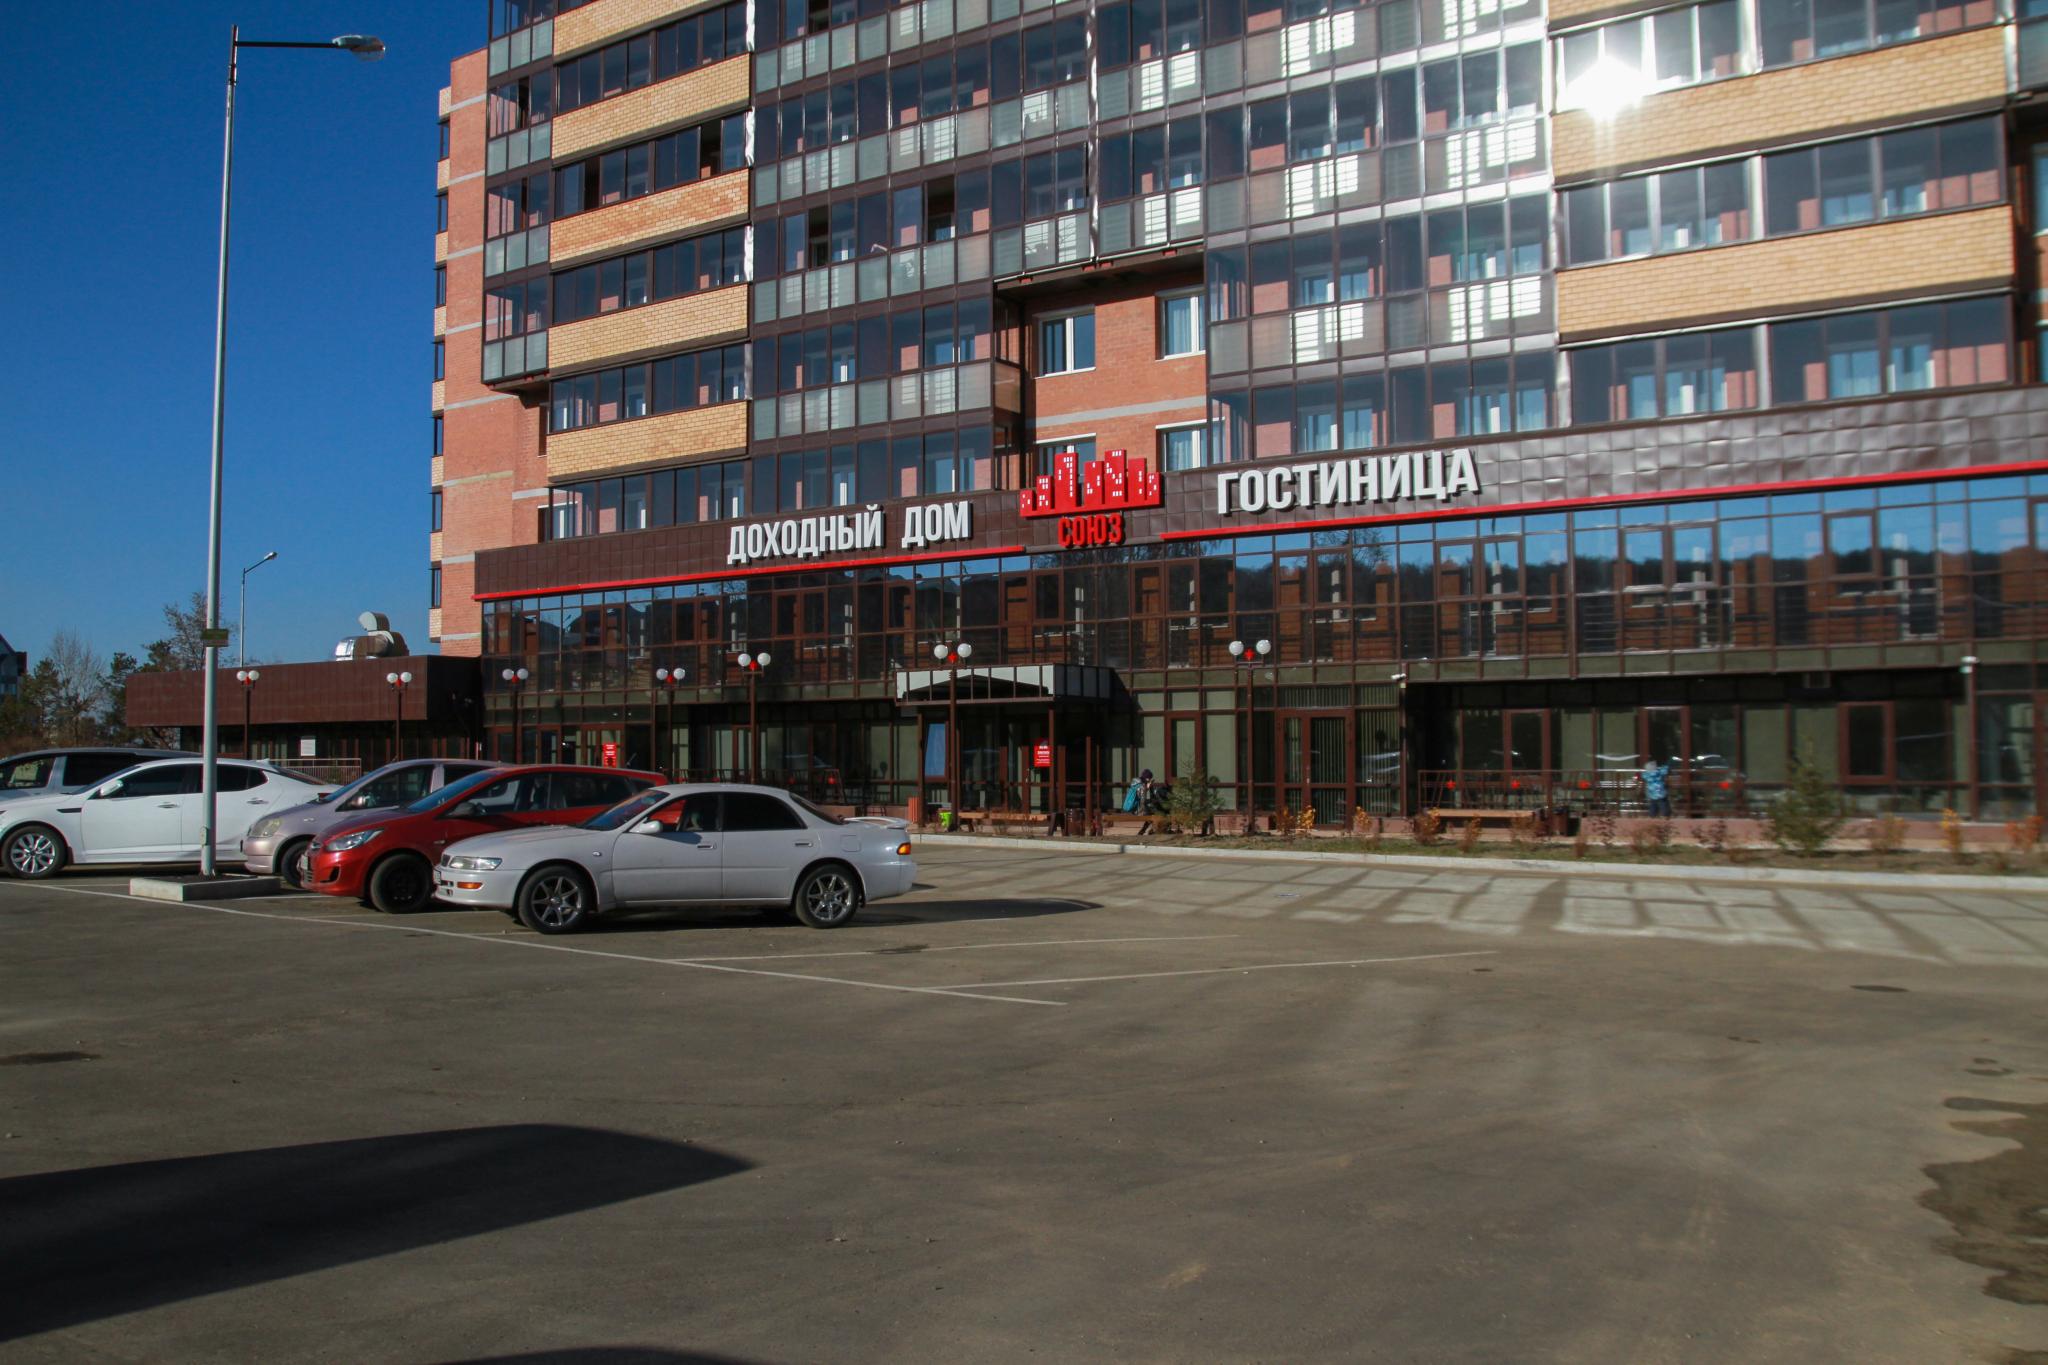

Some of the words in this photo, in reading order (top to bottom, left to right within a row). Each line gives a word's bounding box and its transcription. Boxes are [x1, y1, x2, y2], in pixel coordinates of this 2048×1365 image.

[1217, 448, 1479, 514] ГОСТИНИЦА
[727, 505, 884, 564] ДОХОДНЫЙ
[902, 501, 970, 548] ДОМ
[1058, 512, 1122, 548] СОЮЗ
